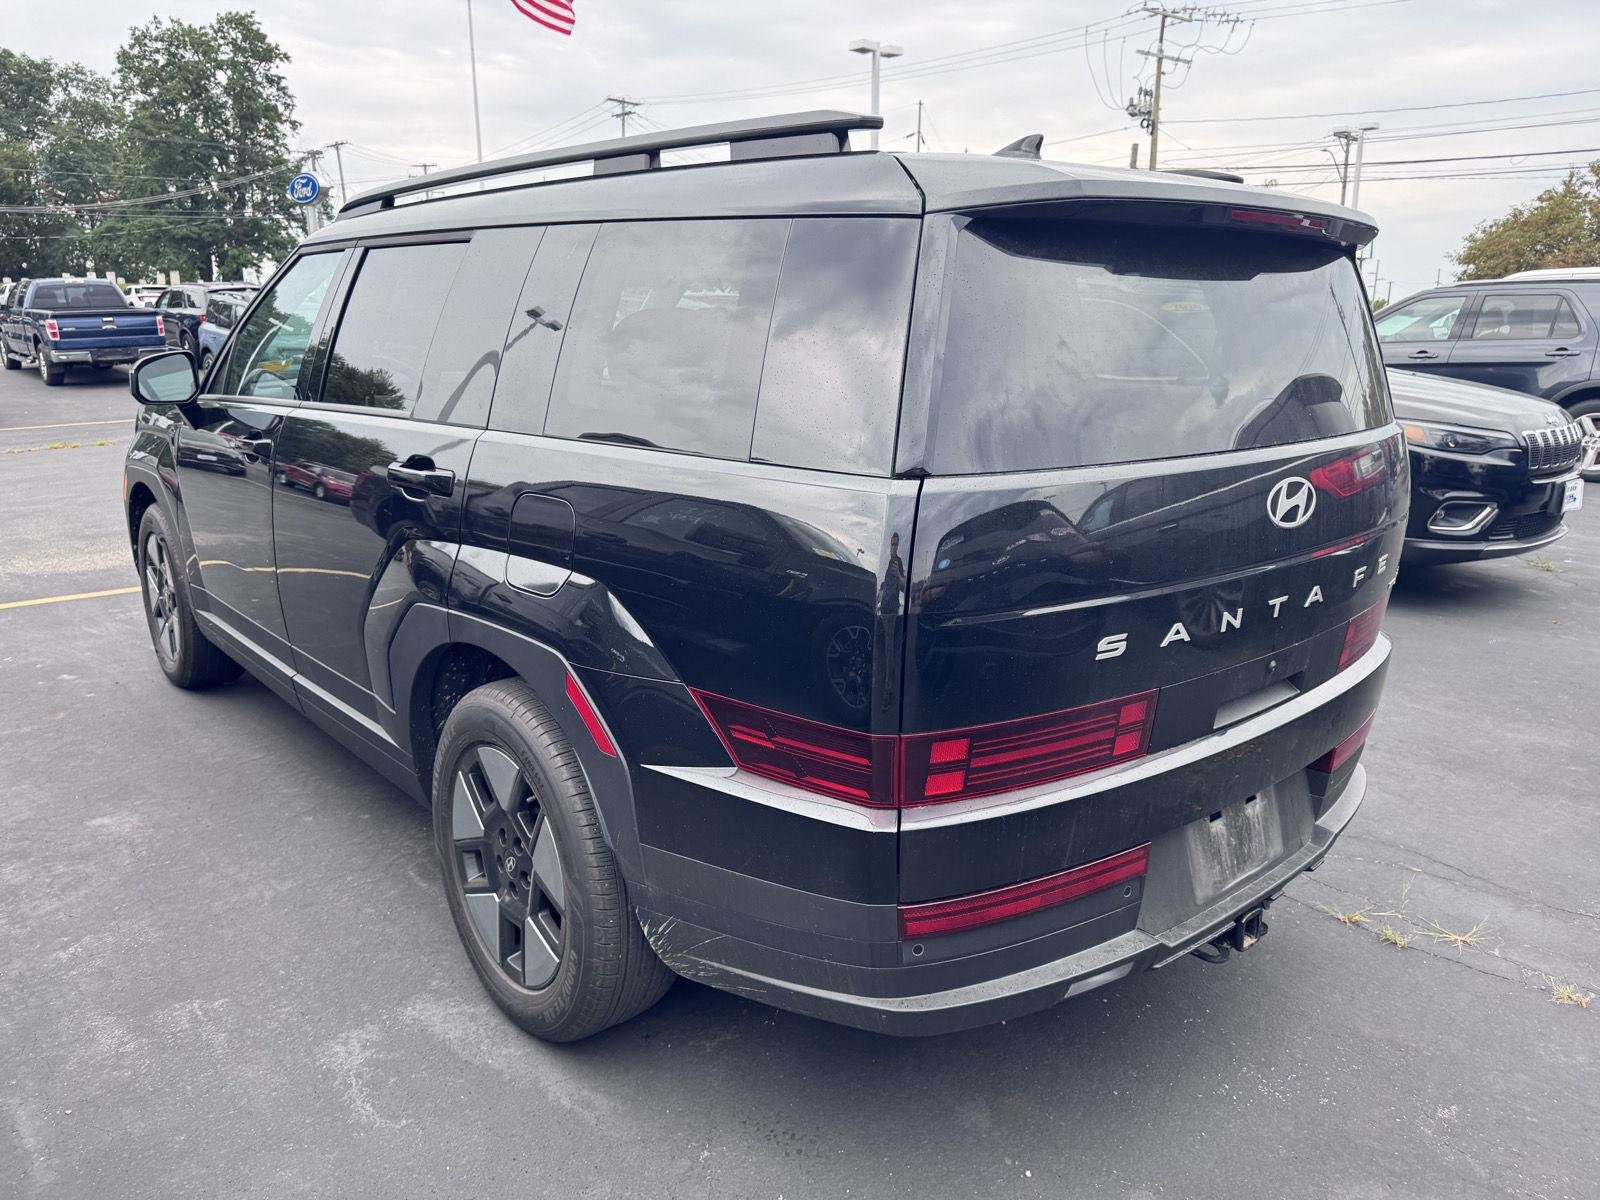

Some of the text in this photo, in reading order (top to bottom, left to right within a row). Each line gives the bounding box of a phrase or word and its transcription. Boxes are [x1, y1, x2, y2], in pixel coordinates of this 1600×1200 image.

[294, 179, 313, 198] Ford
[1095, 585, 1324, 661] SANTA
[1352, 553, 1389, 588] FE
